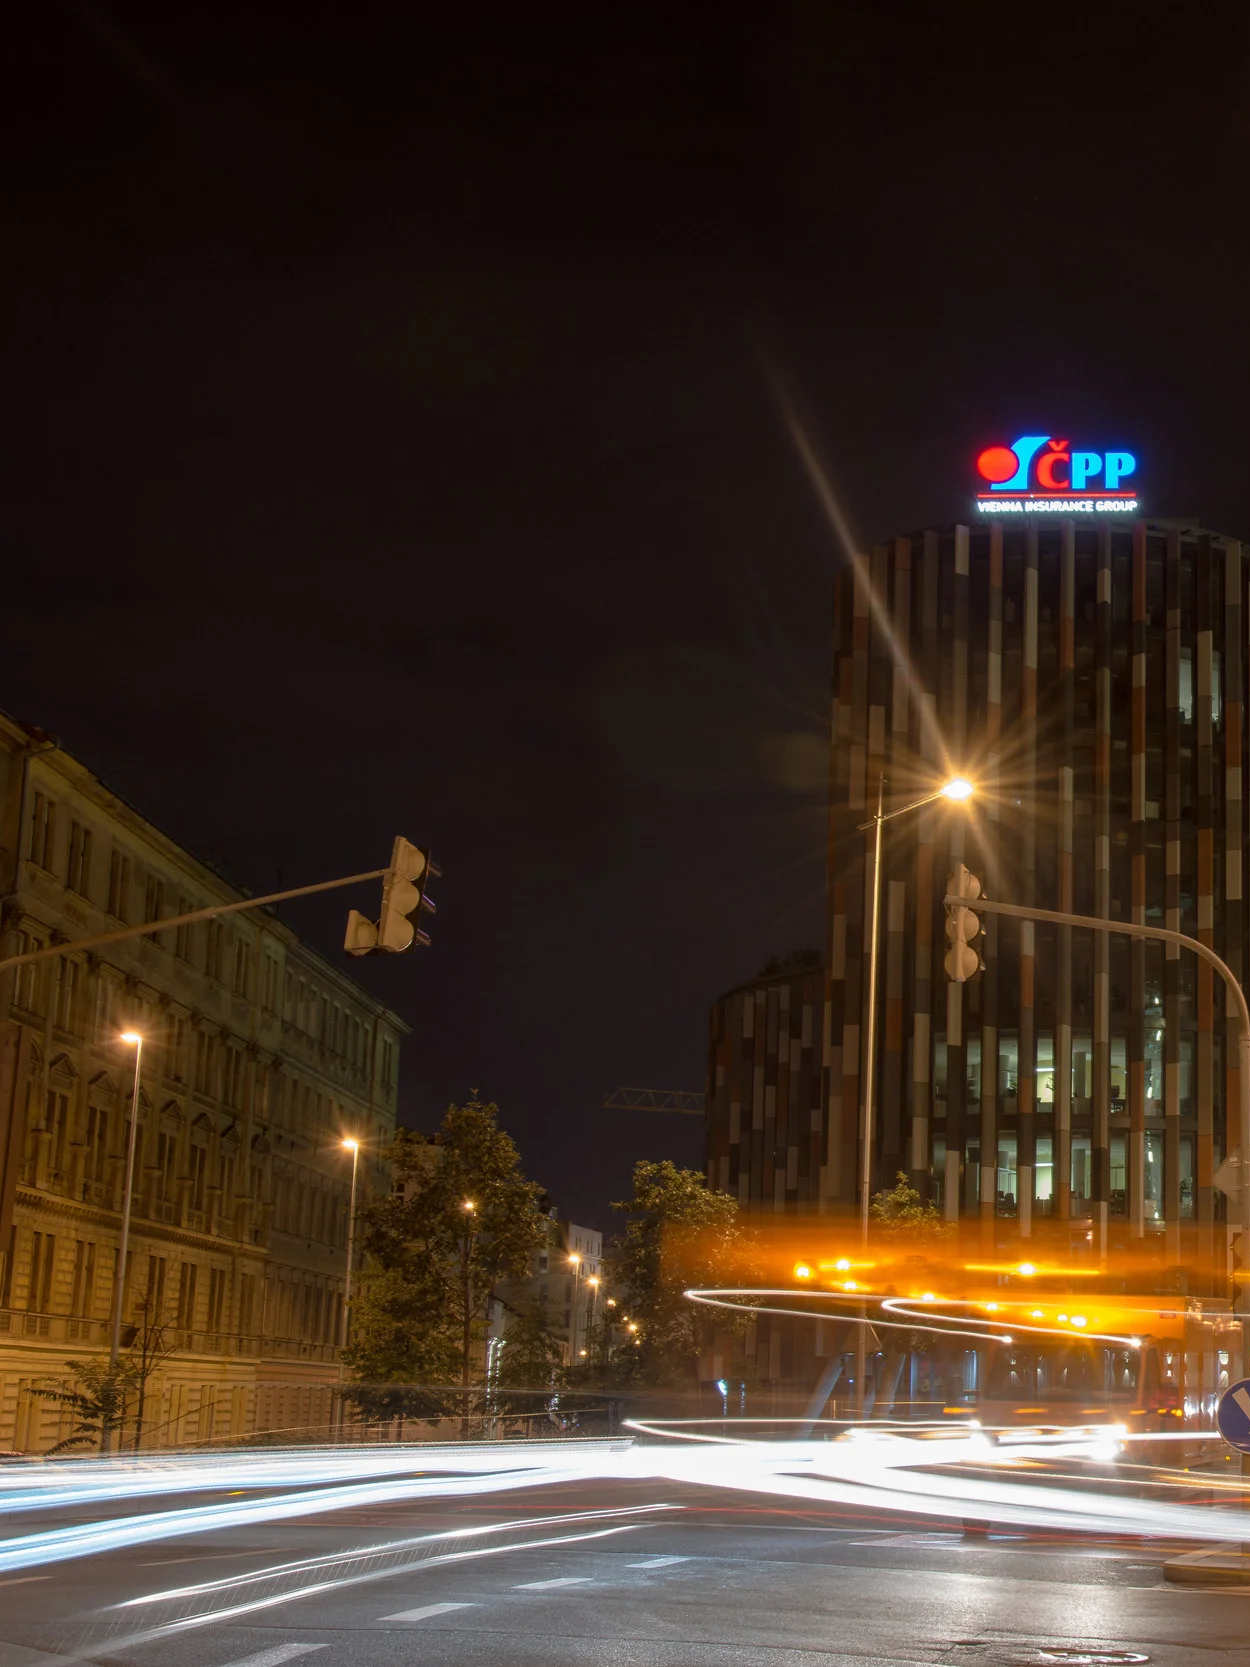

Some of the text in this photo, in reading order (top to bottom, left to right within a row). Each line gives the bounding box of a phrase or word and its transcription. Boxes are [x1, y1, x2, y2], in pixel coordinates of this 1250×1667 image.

[1036, 440, 1137, 489] ČPP
[977, 500, 1138, 512] VIENNA INSURANCE GROUP
